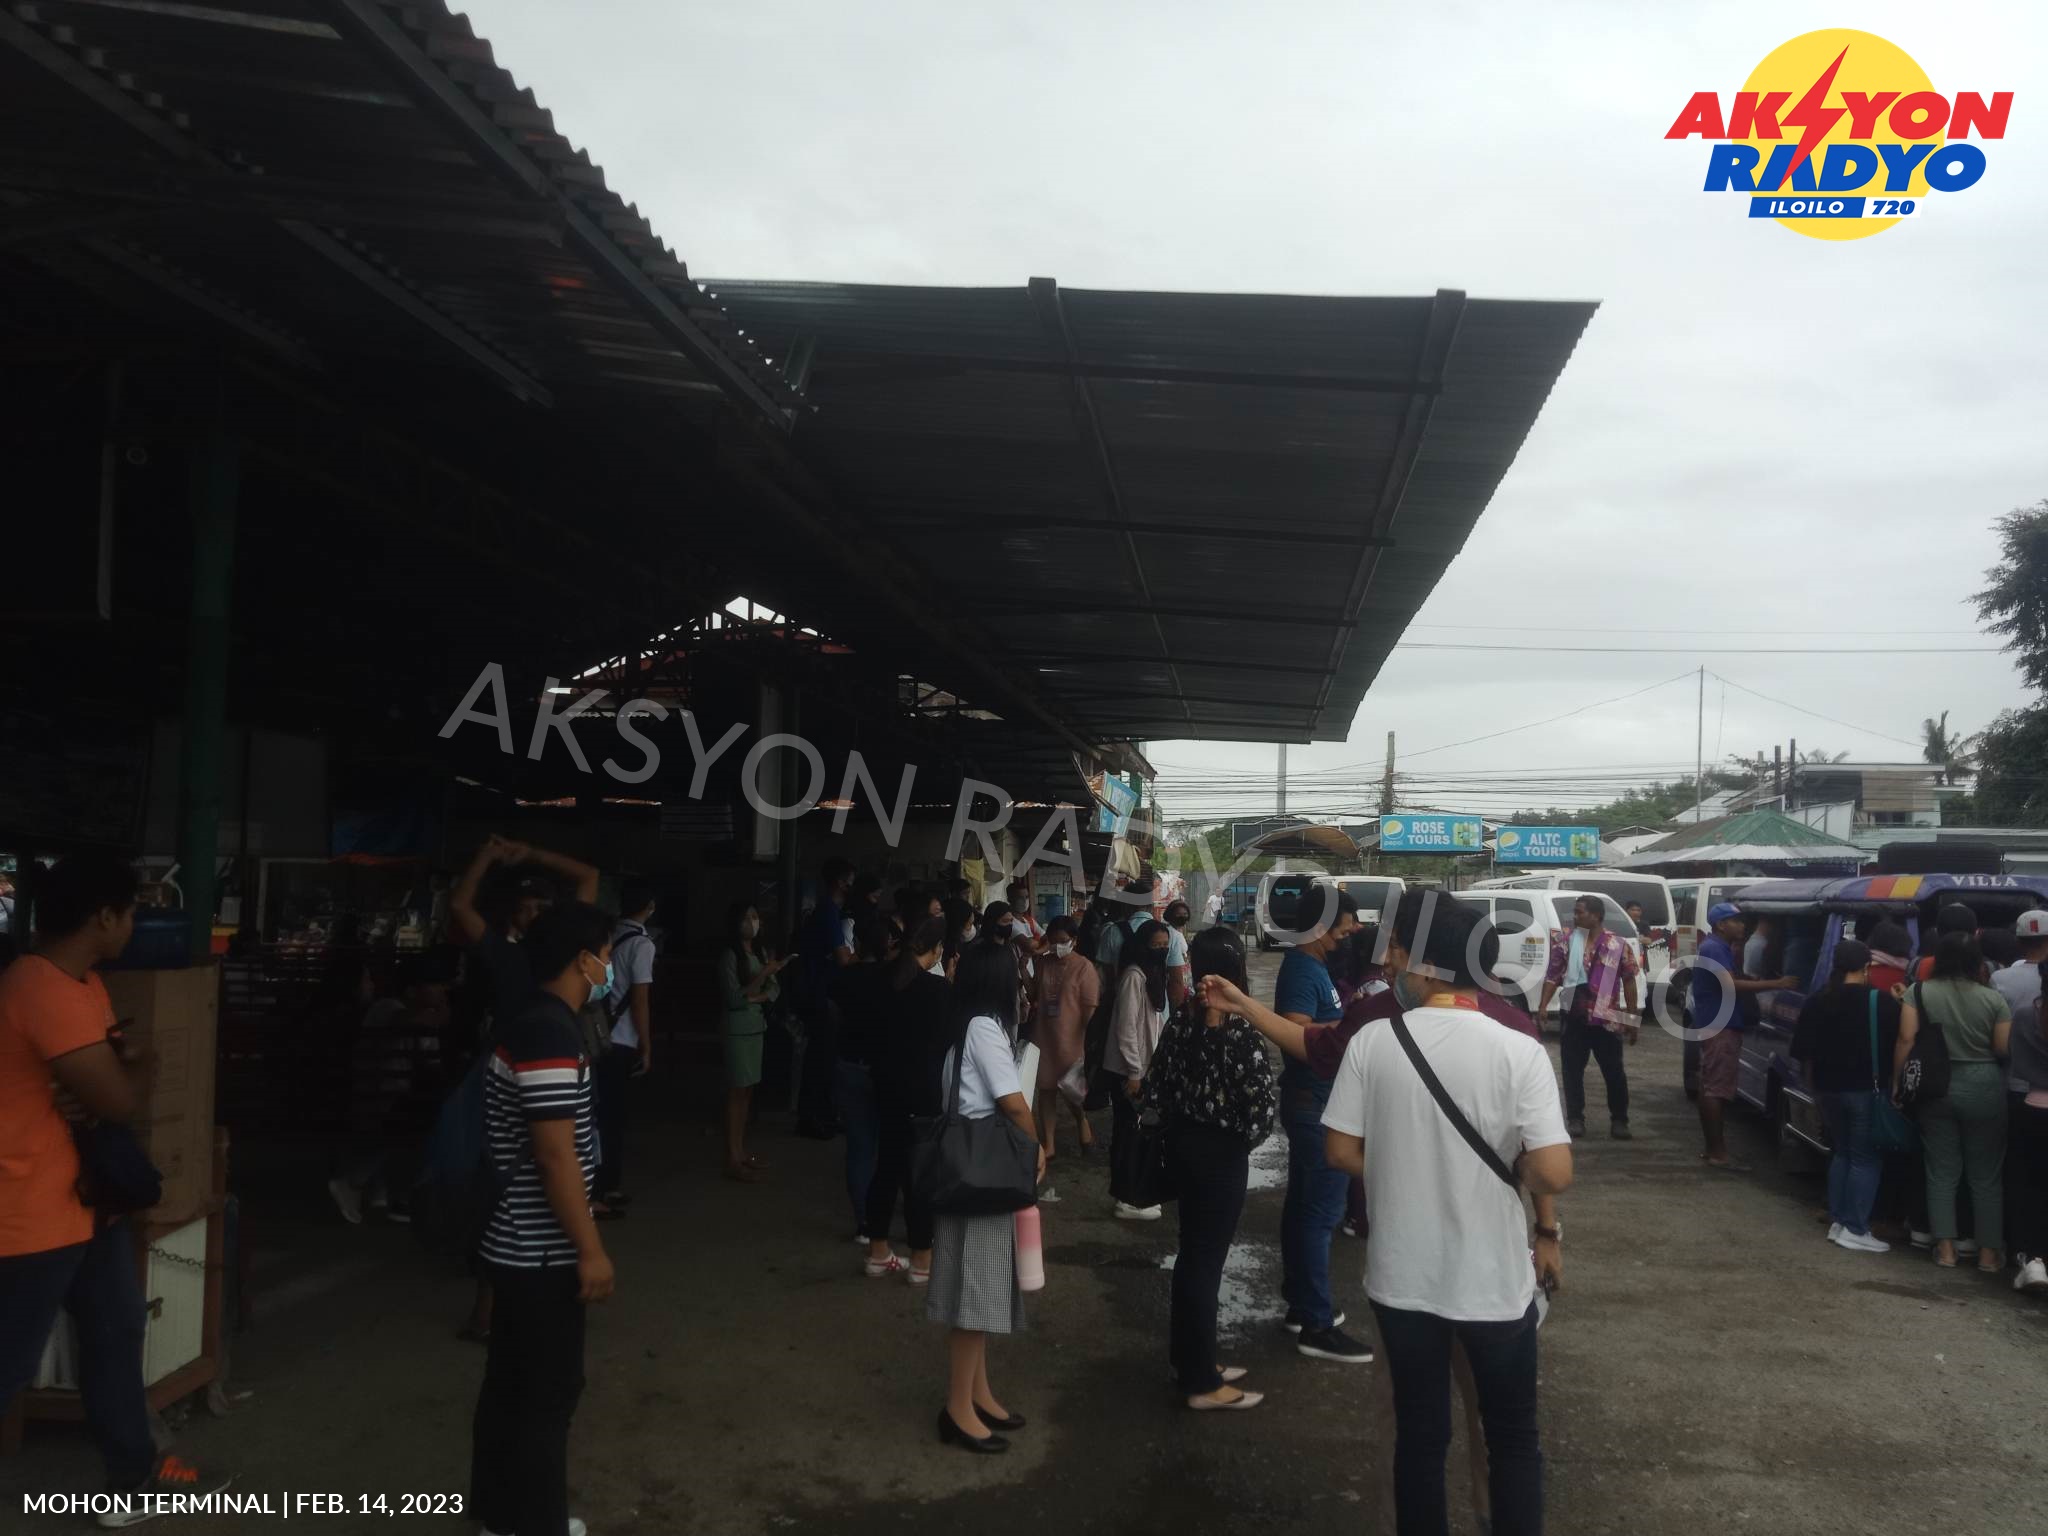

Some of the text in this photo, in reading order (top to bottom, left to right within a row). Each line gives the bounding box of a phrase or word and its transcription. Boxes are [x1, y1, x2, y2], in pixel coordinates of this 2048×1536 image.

[1412, 821, 1445, 834] ROSE
[1407, 834, 1450, 845] TOURS
[1523, 846, 1567, 857] TOURS
[1951, 876, 2018, 887] VILLA
